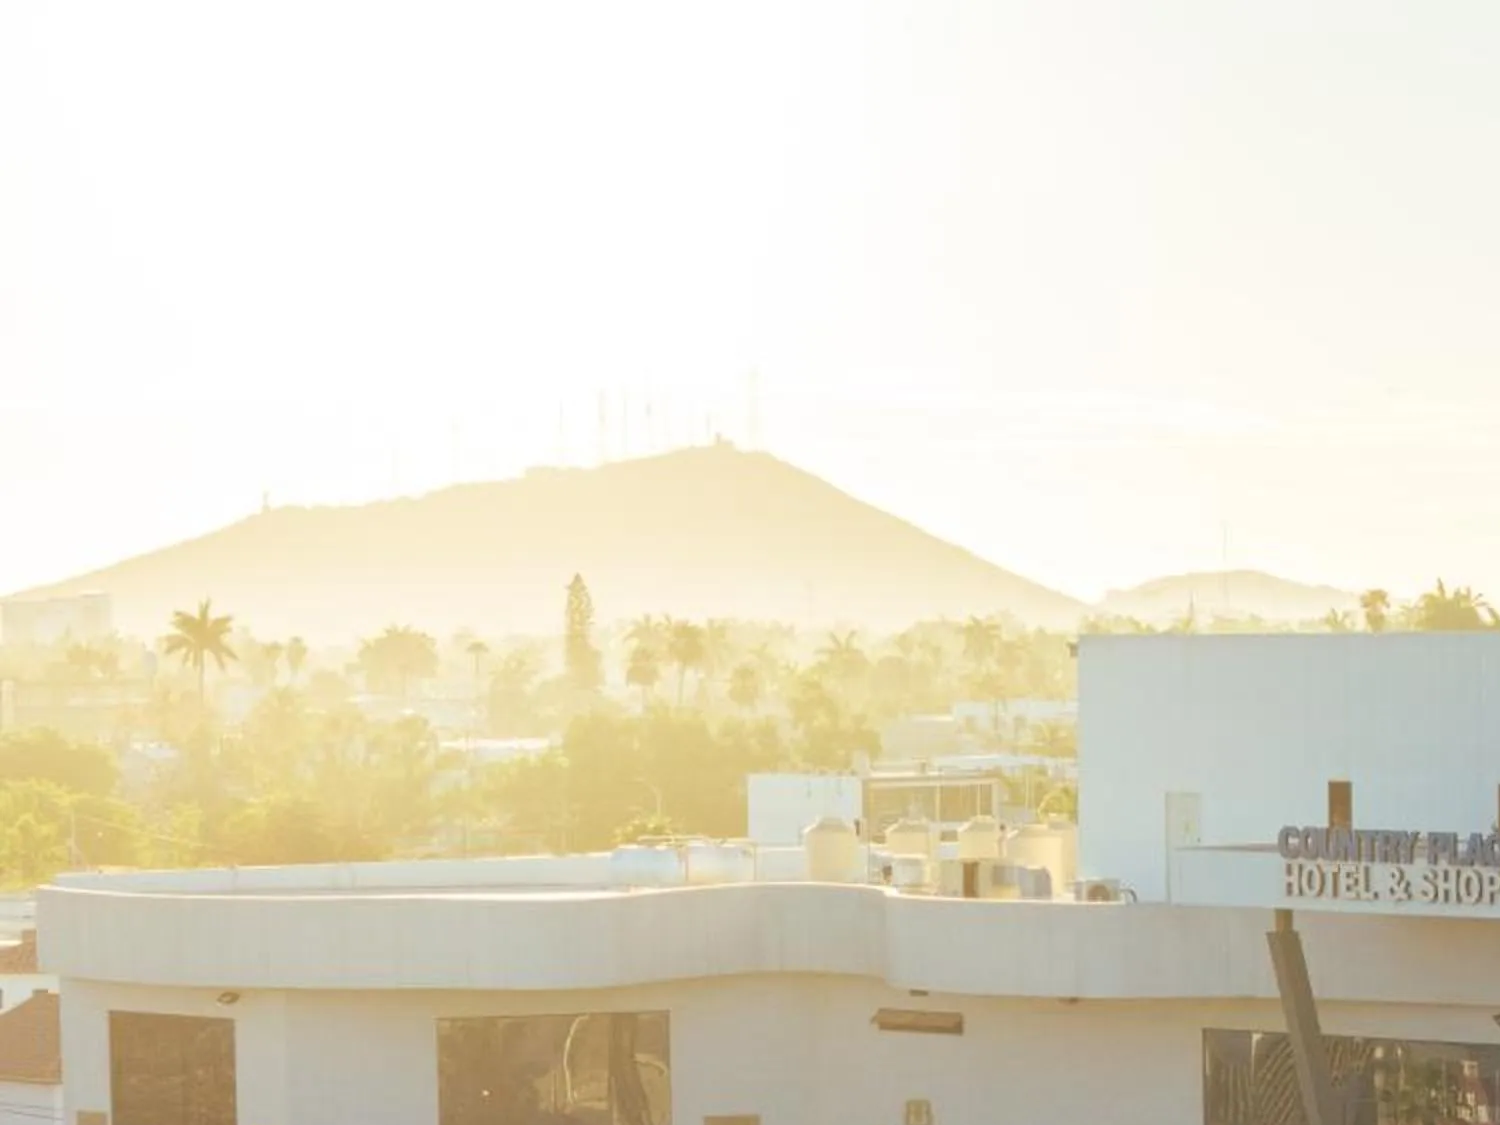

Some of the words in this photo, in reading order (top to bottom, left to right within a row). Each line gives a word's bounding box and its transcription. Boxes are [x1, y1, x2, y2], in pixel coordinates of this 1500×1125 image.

[1278, 825, 1419, 864] COUNTRY
[1285, 862, 1379, 899] HOTEL
[1389, 866, 1411, 901] &
